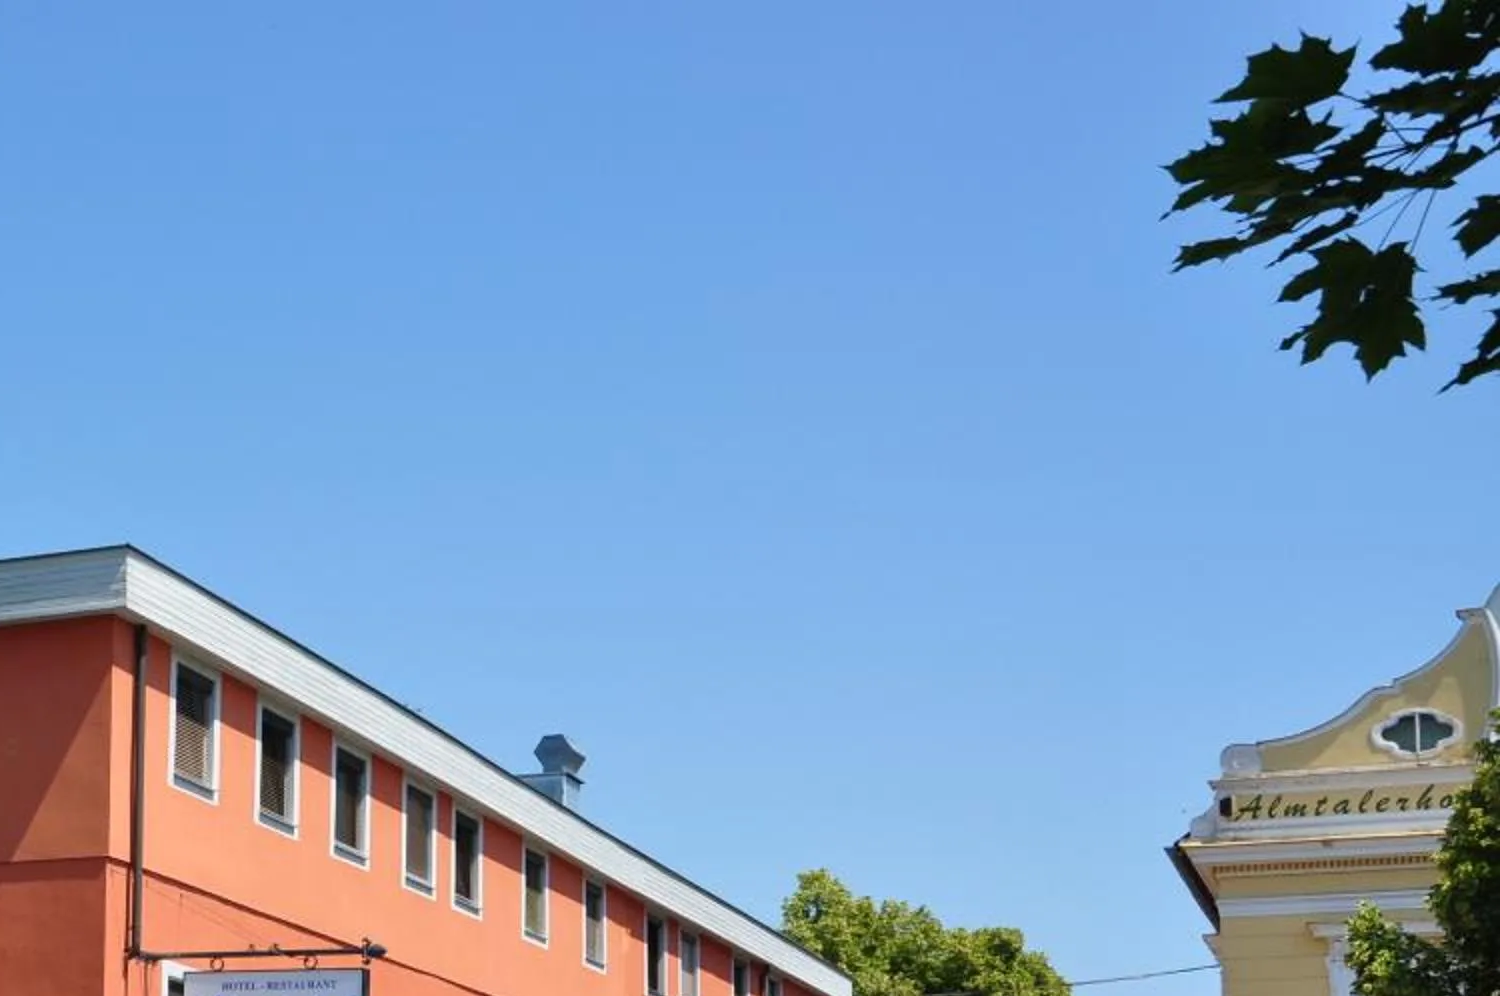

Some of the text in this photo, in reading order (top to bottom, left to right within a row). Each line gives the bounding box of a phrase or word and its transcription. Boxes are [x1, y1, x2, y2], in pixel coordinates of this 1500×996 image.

[1234, 784, 1454, 821] Almtalerho
[221, 981, 256, 992] HOTEL
[267, 979, 338, 991] RESTAURANT
